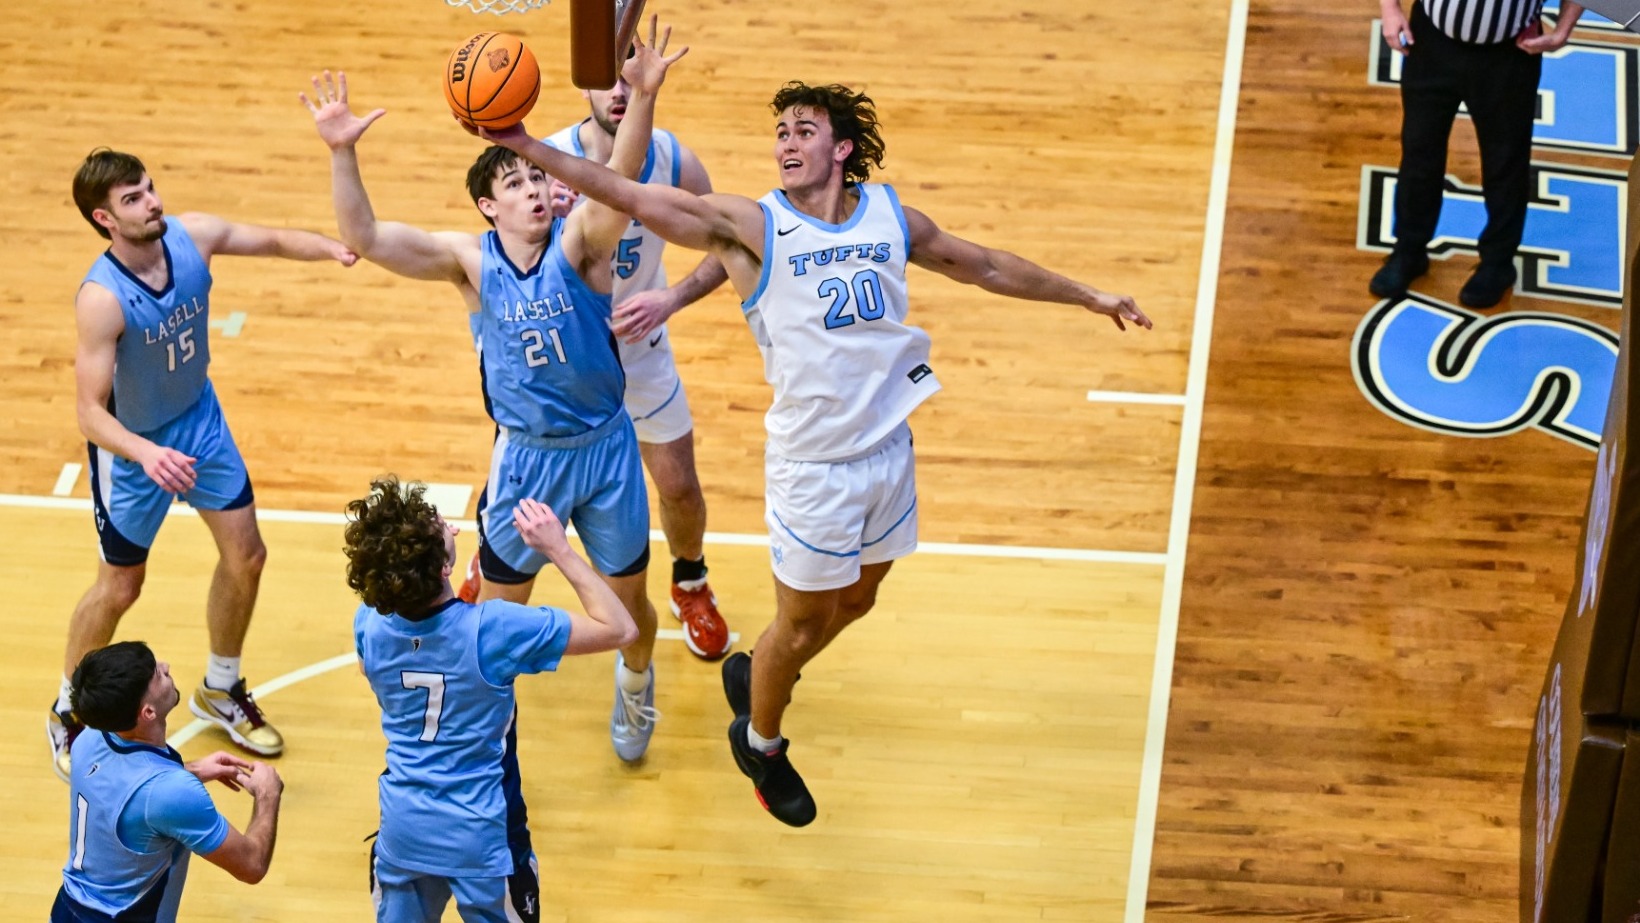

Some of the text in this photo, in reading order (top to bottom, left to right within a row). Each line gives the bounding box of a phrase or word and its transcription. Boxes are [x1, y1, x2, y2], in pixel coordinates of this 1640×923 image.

[611, 235, 643, 280] 5
[788, 242, 891, 277] TUFTS
[144, 296, 204, 345] LASELL
[503, 292, 574, 322] LASELL
[817, 268, 886, 330] 20
[166, 326, 196, 373] 15
[520, 326, 568, 369] 21
[401, 670, 446, 743] 7
[72, 791, 89, 872] 1
